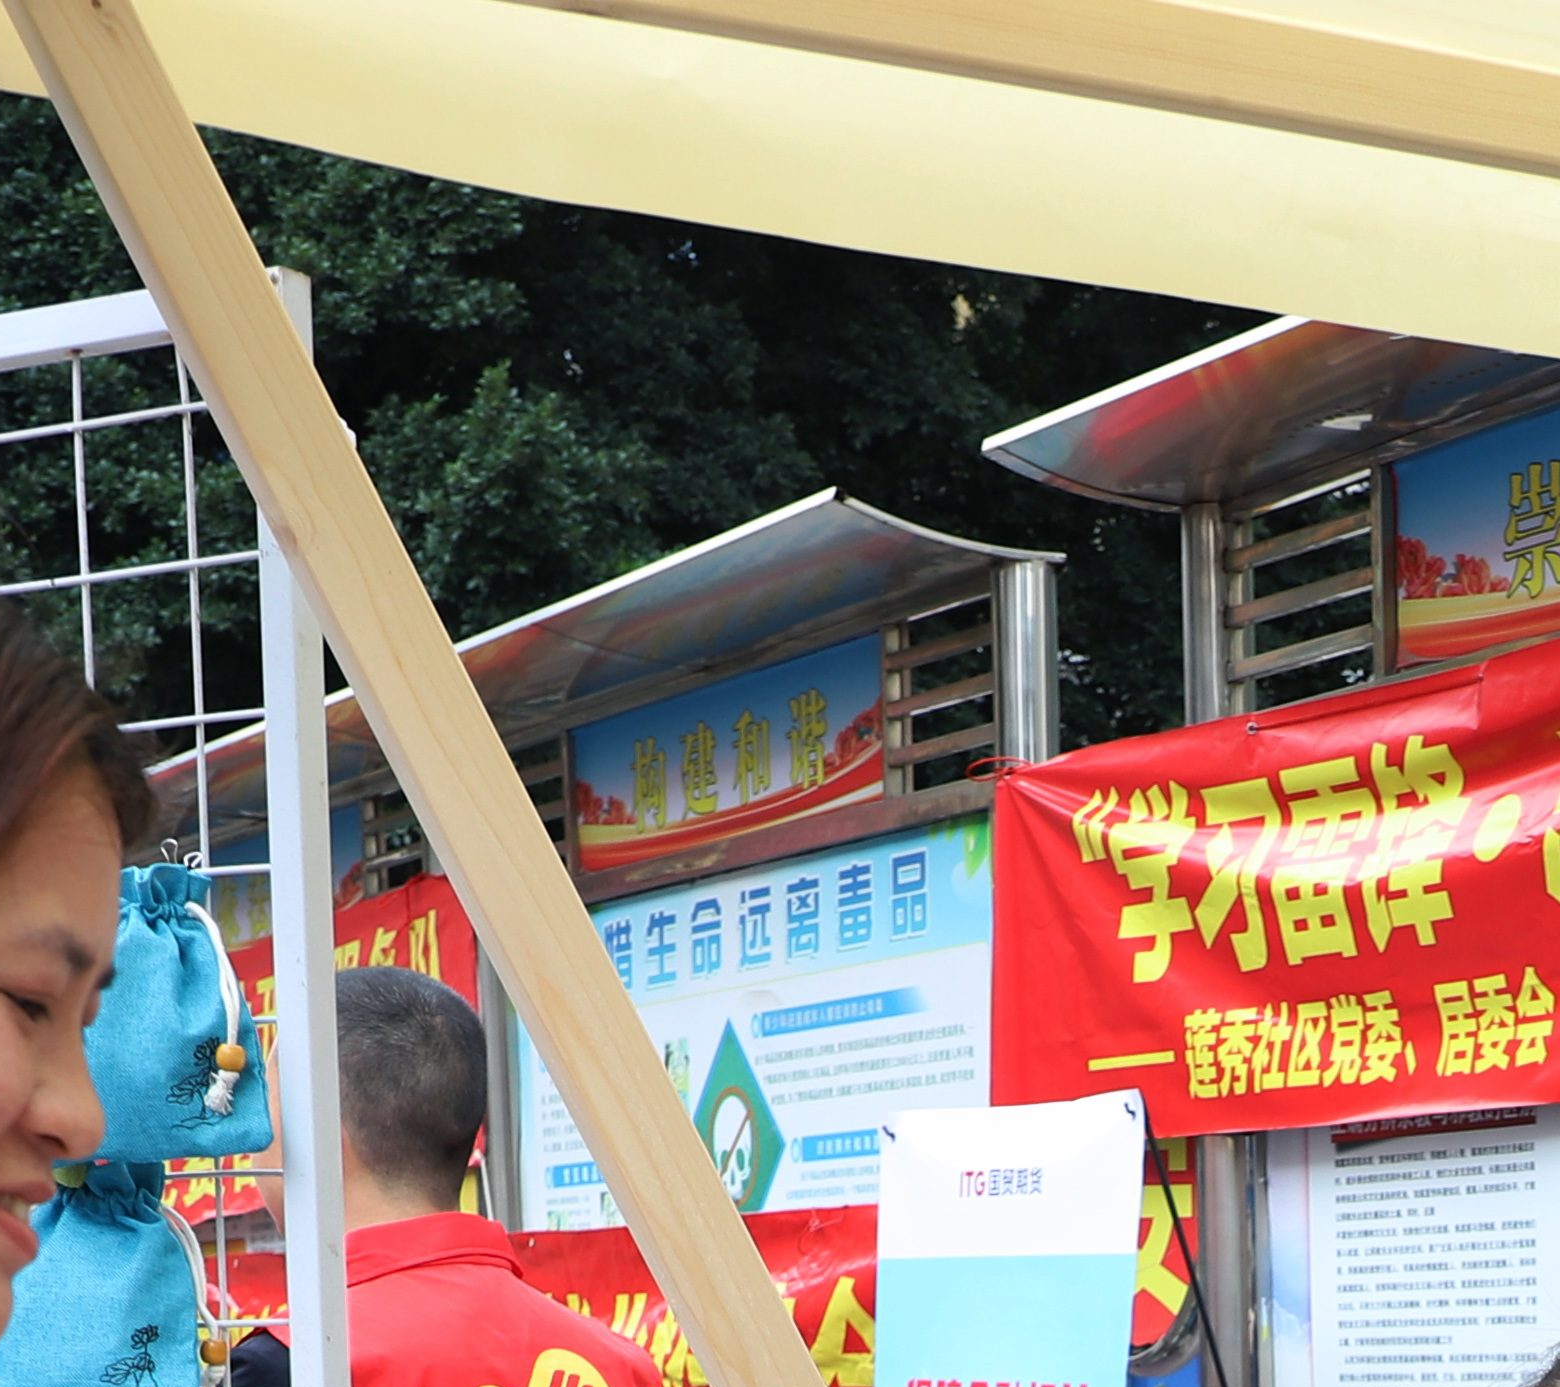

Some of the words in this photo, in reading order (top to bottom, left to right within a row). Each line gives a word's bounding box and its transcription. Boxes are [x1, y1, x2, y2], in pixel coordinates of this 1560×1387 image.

[630, 688, 828, 834] 构建和谐
[959, 1169, 985, 1198] ITG
[988, 1167, 1043, 1197] 国贸期货
